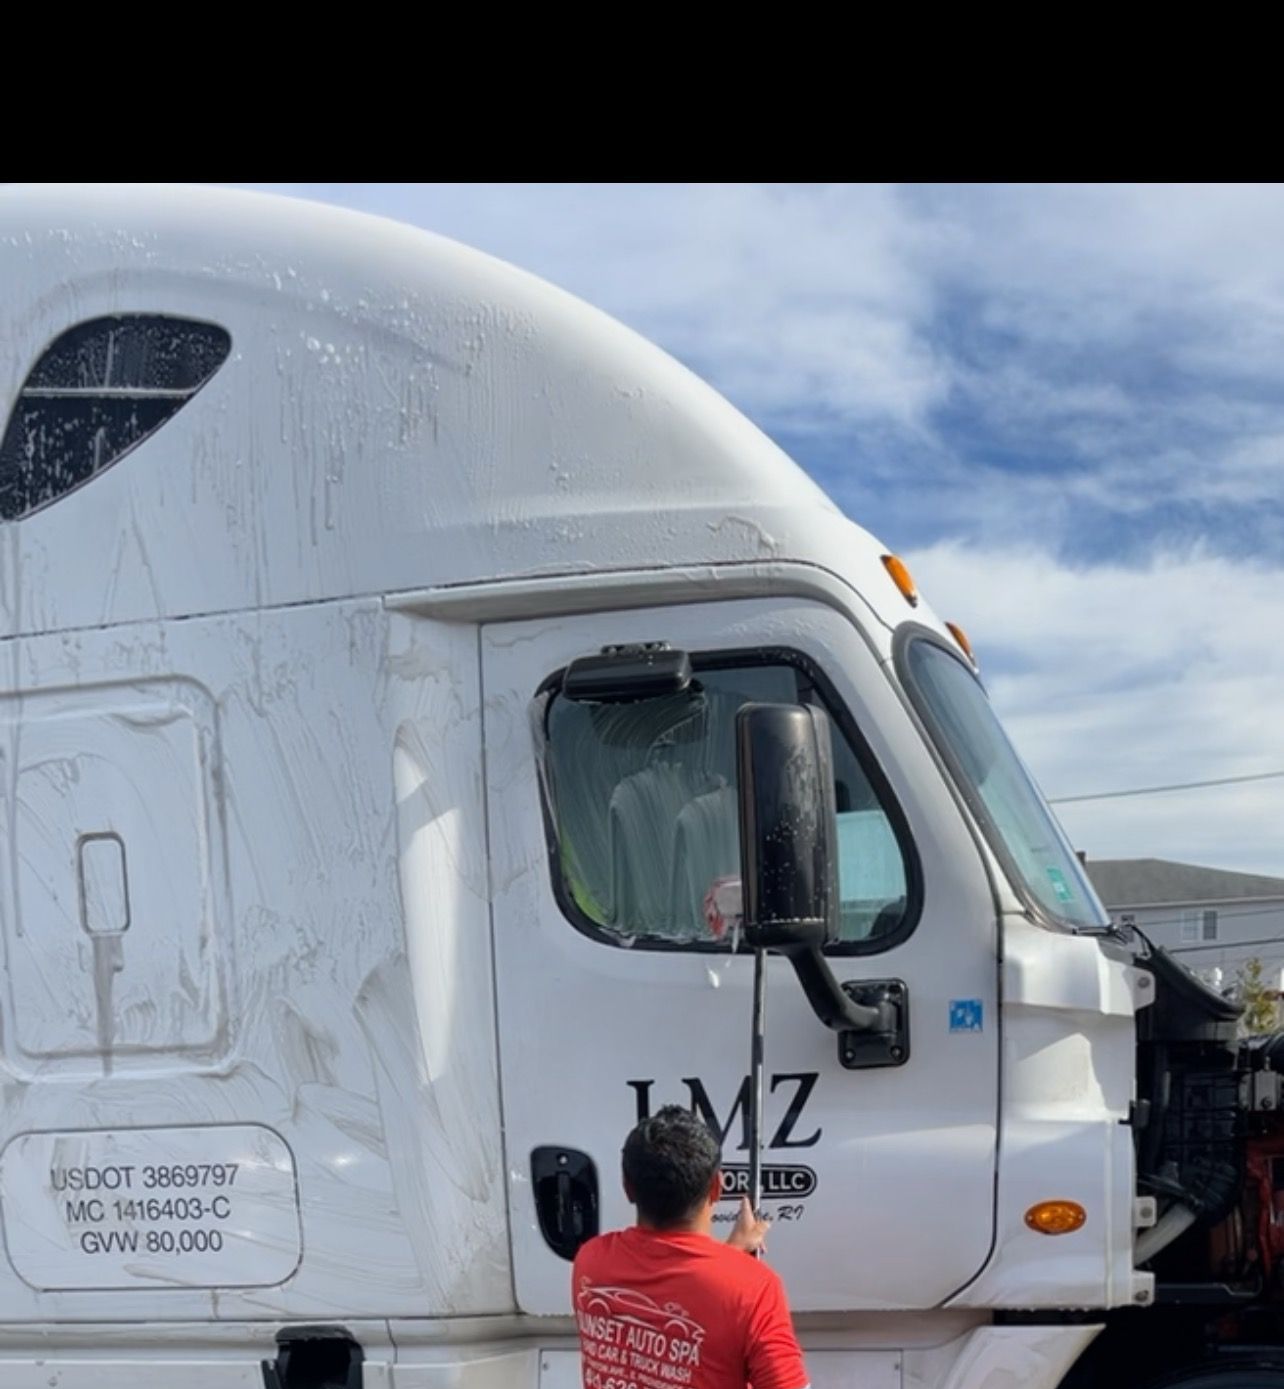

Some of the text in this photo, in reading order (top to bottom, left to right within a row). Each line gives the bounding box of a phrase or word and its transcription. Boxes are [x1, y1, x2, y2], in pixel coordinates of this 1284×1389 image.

[50, 1163, 240, 1191] USDOT 3869797
[768, 1172, 805, 1190] LLC
[66, 1195, 231, 1223] MC 1416403-C
[80, 1229, 223, 1256] GVW 80,000
[626, 1325, 668, 1359] AUTO
[669, 1338, 700, 1368] SPA
[598, 1342, 620, 1363] CAR
[630, 1350, 660, 1377] TRUCK
[661, 1361, 693, 1384] WASH
